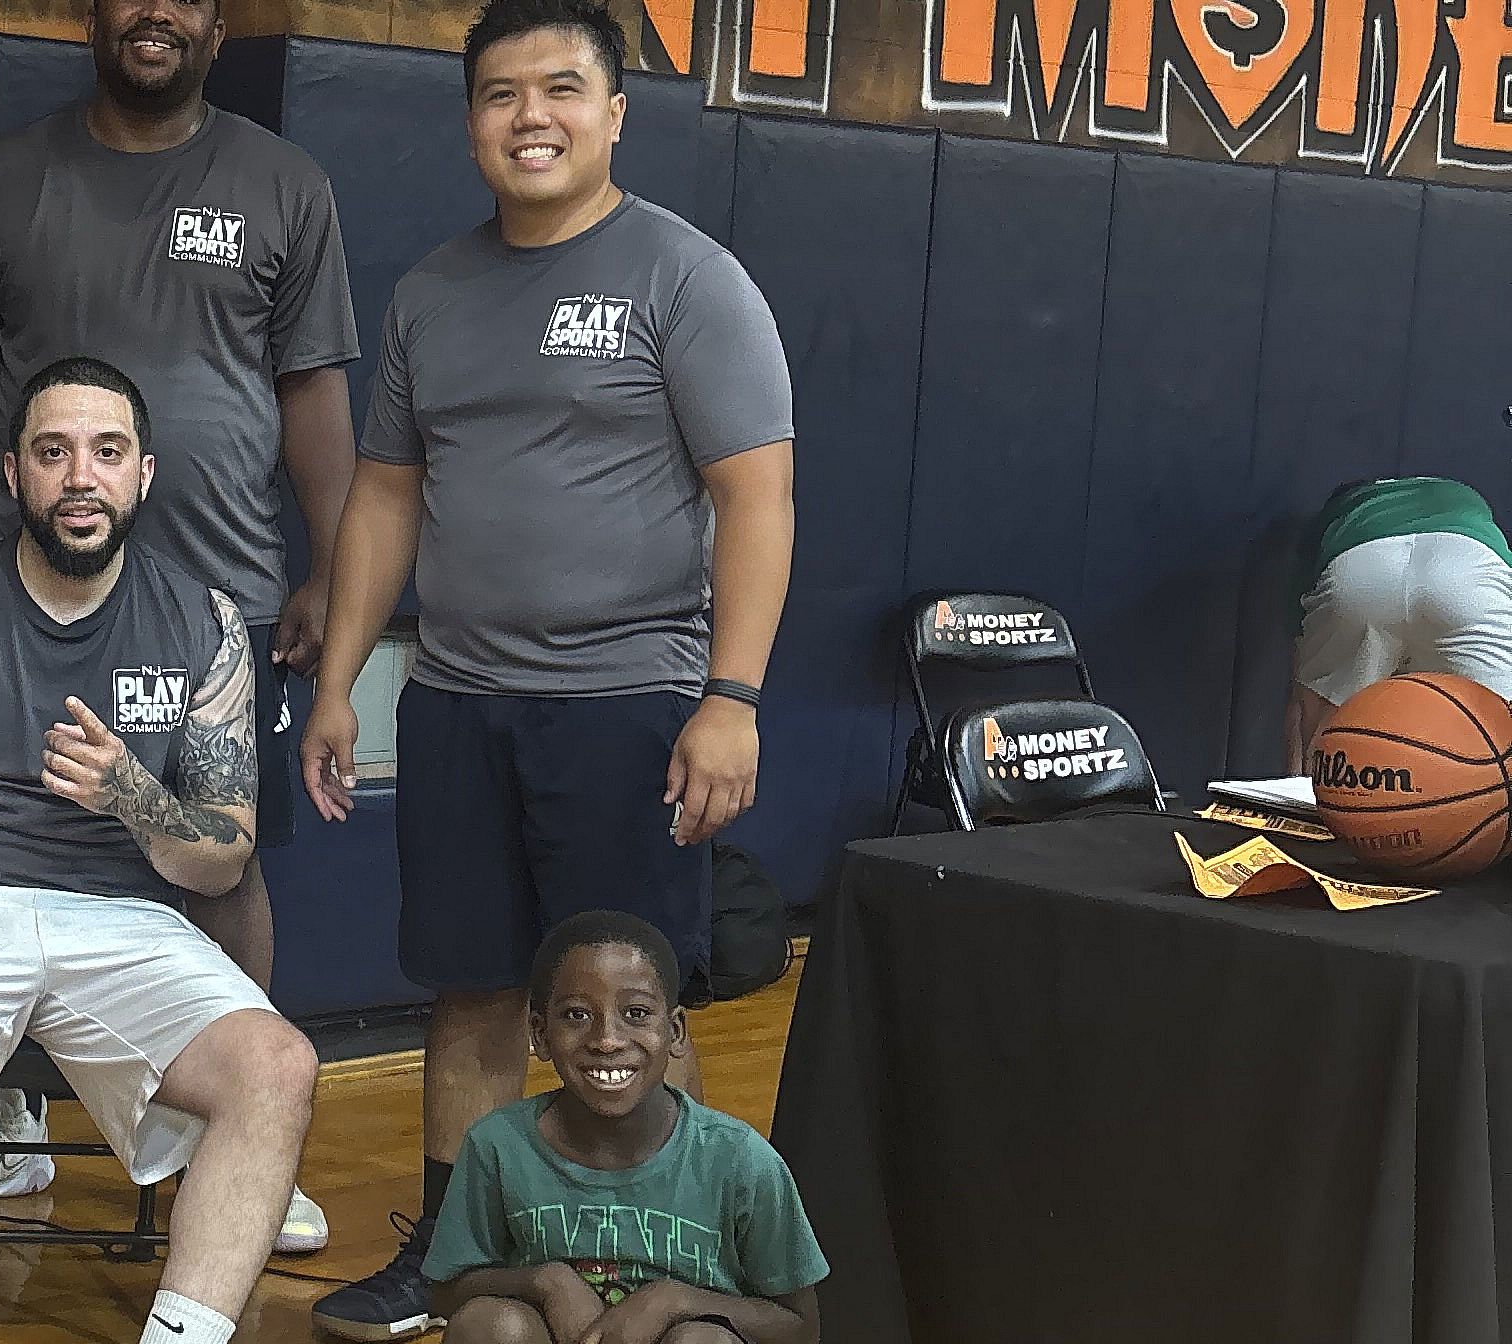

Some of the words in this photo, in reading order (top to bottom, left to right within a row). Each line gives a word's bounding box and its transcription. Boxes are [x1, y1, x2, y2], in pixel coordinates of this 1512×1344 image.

[202, 206, 221, 218] NJ
[177, 214, 242, 243] PLAY
[174, 236, 239, 260] SPORTS
[173, 252, 237, 269] COMMUNITY
[583, 293, 605, 304] NJ
[552, 303, 626, 330] PLAY
[547, 328, 620, 350] SPORTS
[544, 347, 618, 360] COMMUNITY
[967, 613, 1044, 629] MONEY
[969, 628, 1057, 645] SPORTZ
[141, 663, 162, 677] NJ
[117, 676, 185, 704] PLAY
[1017, 725, 1109, 757] MONEY
[1023, 748, 1129, 782] SPORTZ
